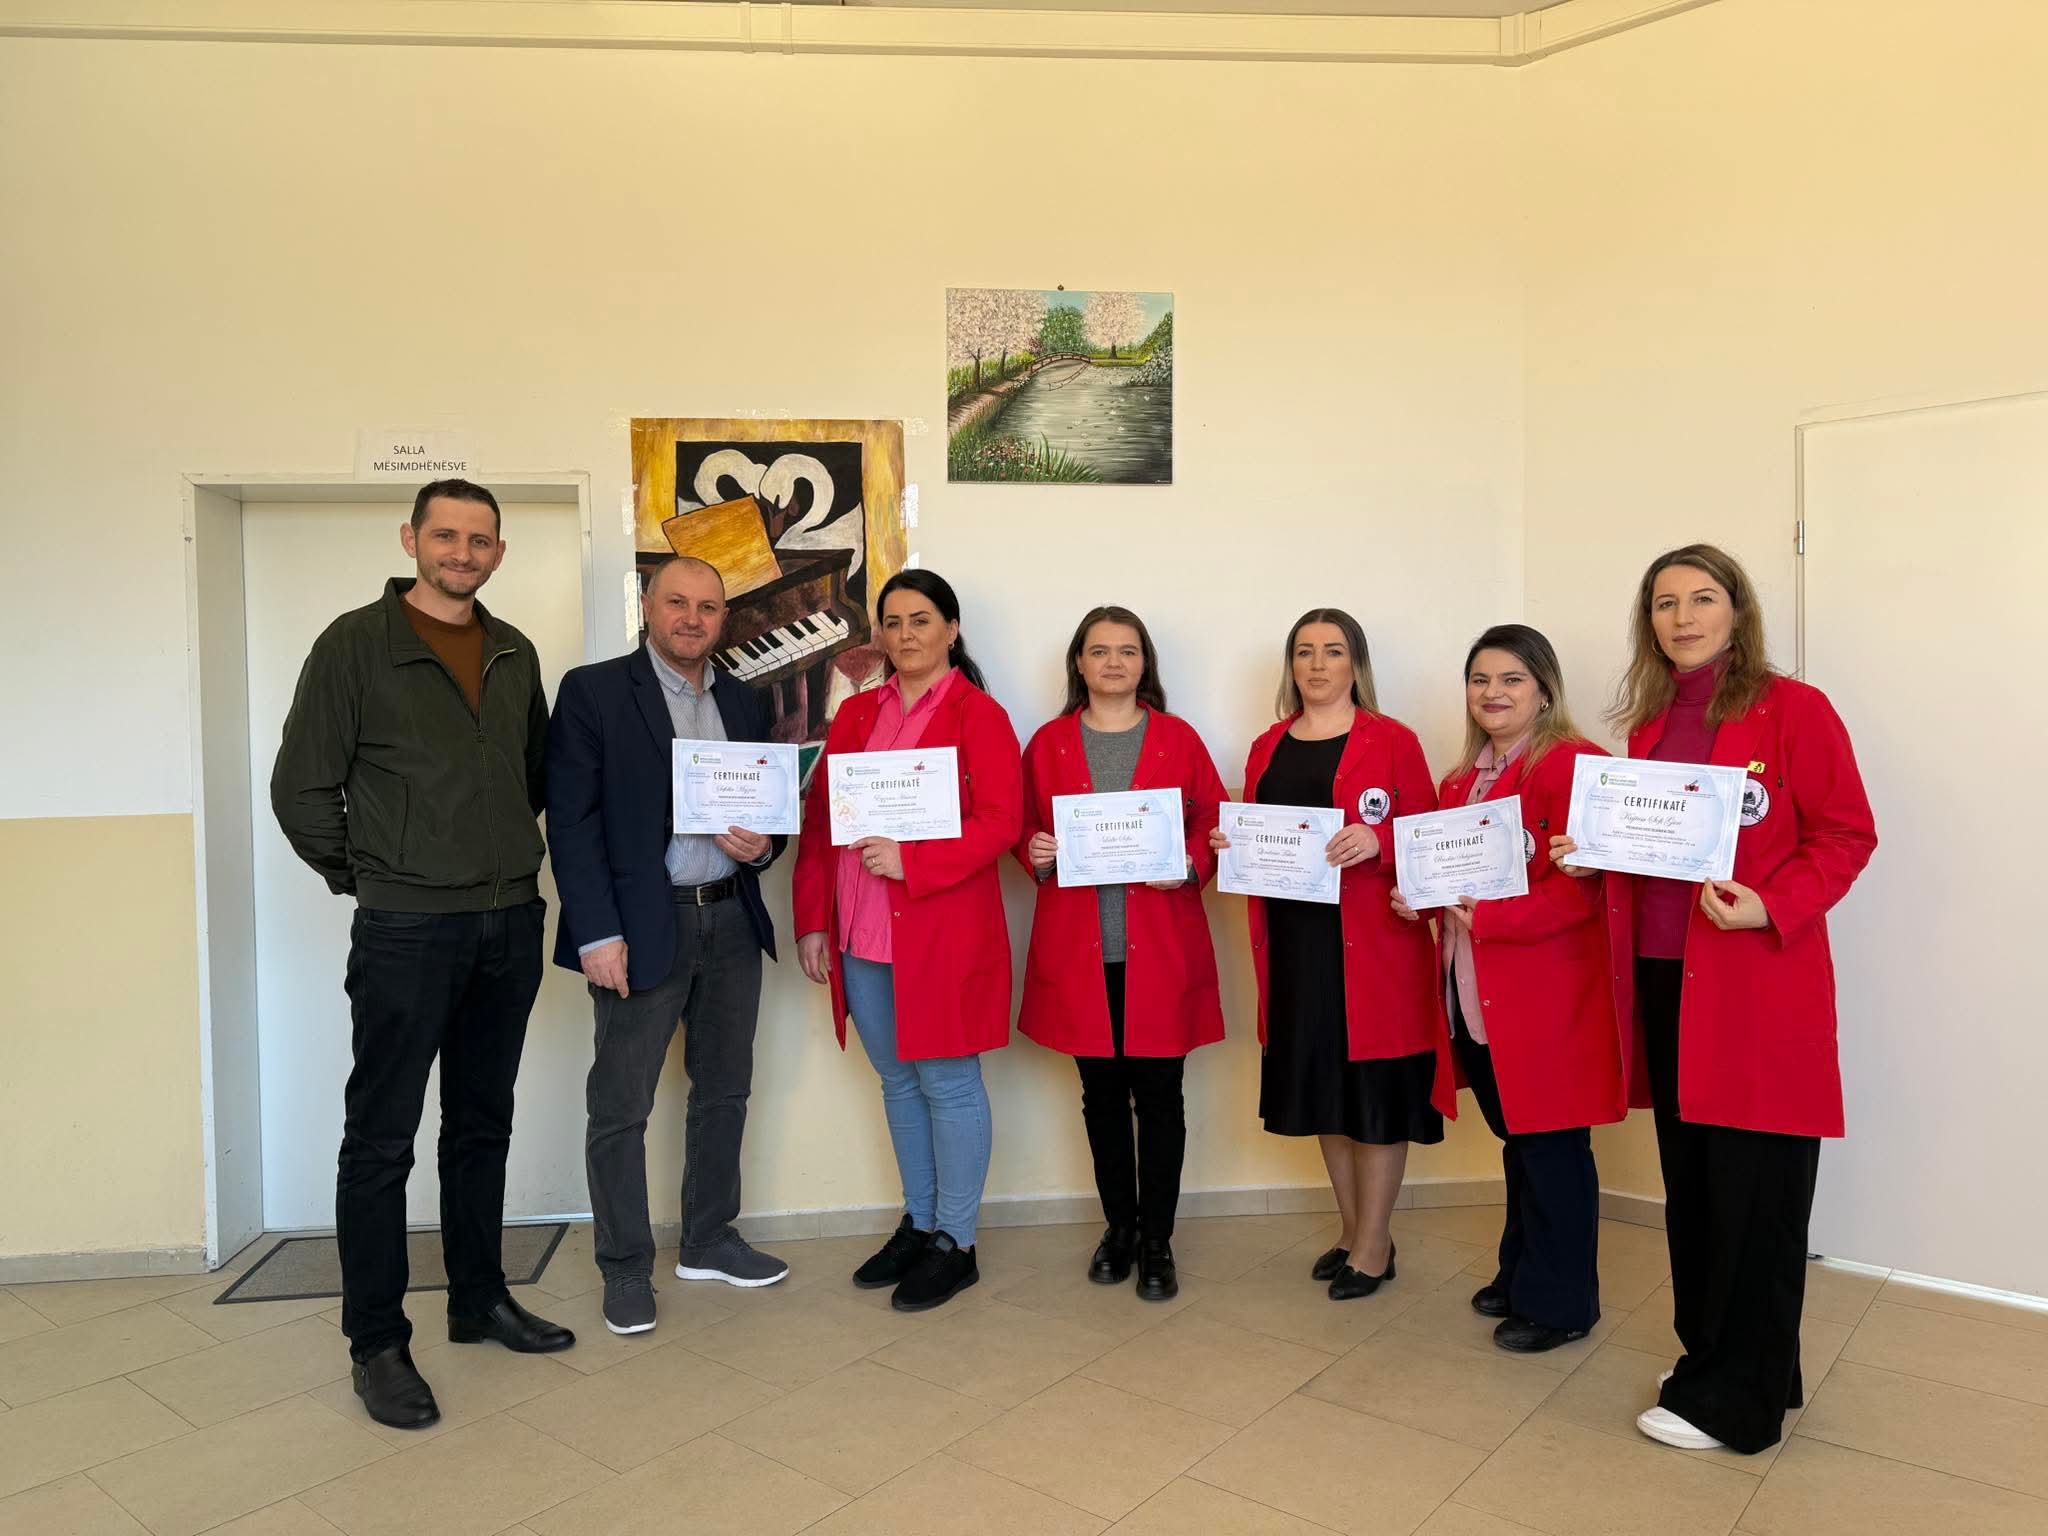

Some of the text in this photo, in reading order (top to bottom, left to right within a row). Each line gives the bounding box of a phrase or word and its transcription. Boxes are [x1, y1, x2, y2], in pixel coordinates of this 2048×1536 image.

[393, 445, 425, 455] SALLA
[373, 460, 467, 471] MËSIMDHËNËSVE
[713, 770, 760, 781] CERTIFIKATË
[870, 777, 920, 790] CERTIFIKATË
[1624, 795, 1687, 812] CERTIFIKATË
[1095, 818, 1143, 832] CERTIFIKATË
[1255, 834, 1302, 846] CERTIFIKATË
[1435, 833, 1484, 851] CERTIFIKATË
